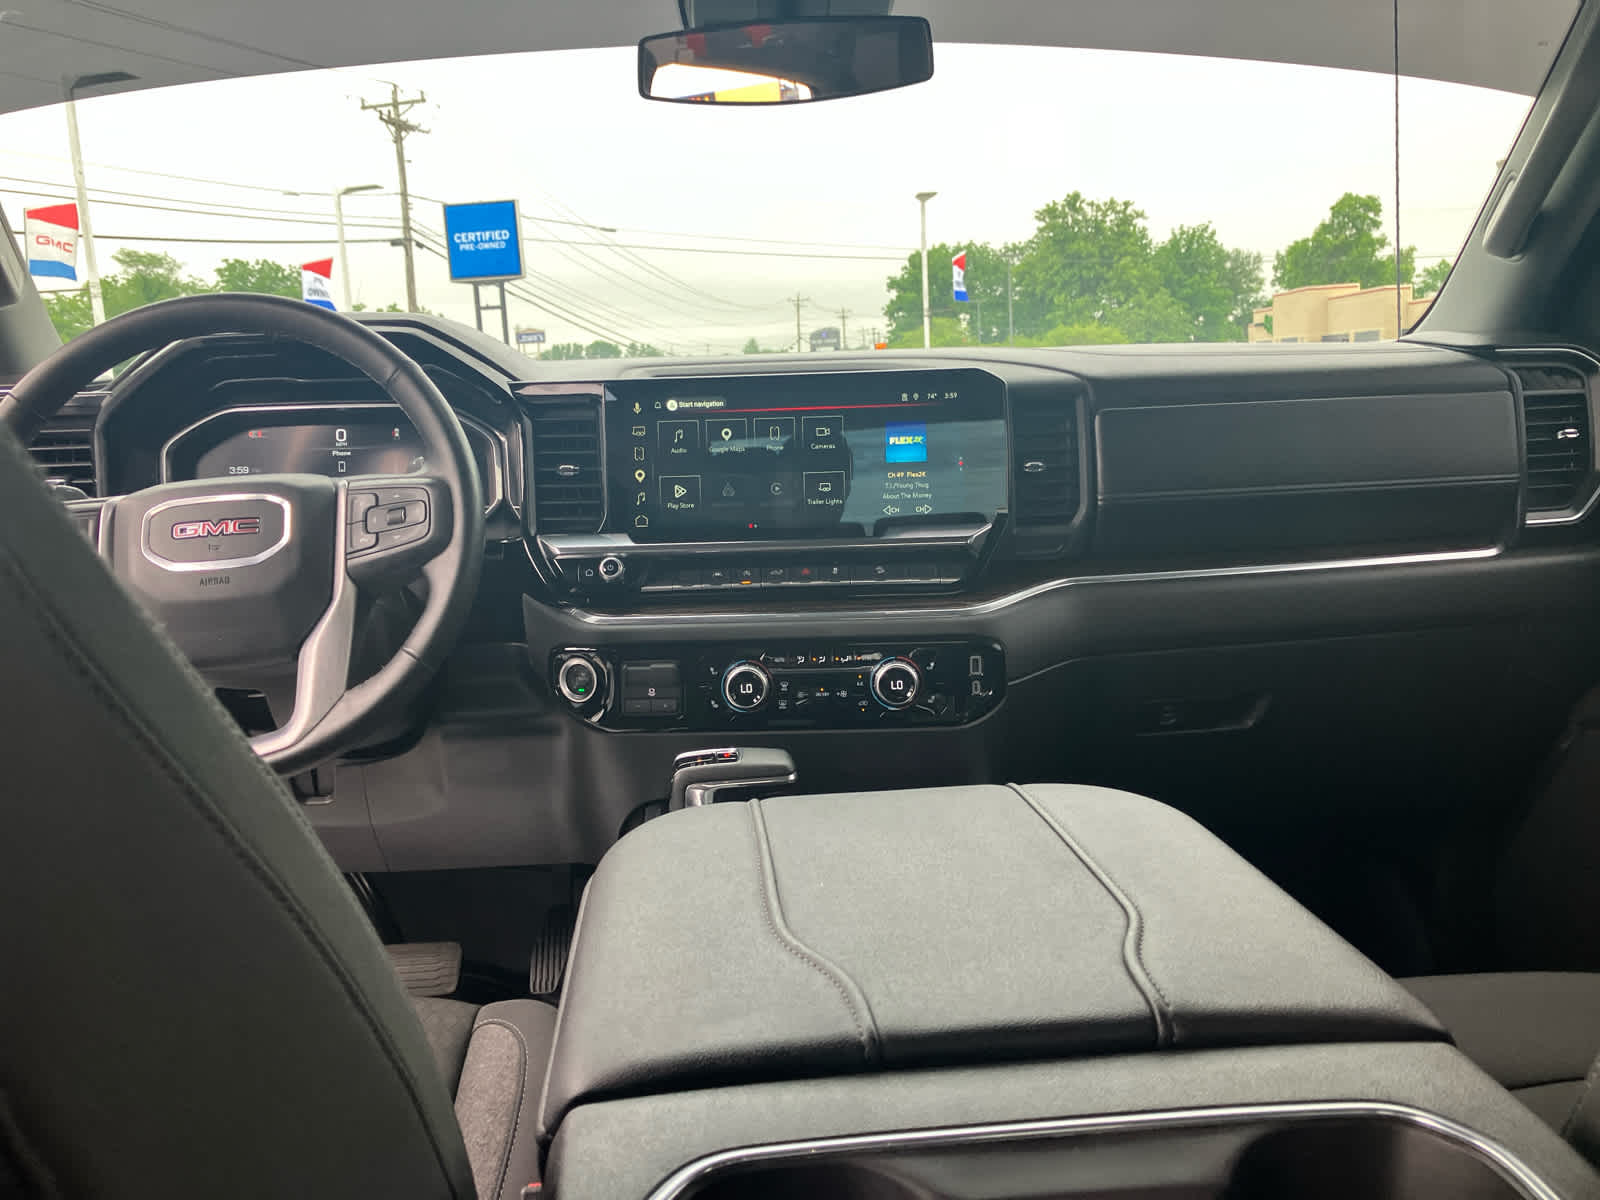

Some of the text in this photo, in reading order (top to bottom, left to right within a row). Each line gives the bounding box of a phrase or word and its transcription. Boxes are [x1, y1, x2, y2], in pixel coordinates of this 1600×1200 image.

[453, 230, 509, 243] CERTIFIED
[36, 234, 73, 254] GMC
[459, 241, 506, 251] PRE-OWNED
[693, 400, 724, 409] navigation
[709, 445, 729, 454] Google
[229, 466, 249, 474] 3:59
[667, 502, 679, 510] Play
[825, 497, 843, 506] Lights
[171, 517, 260, 540] GMC
[199, 576, 230, 587] AIRBAG
[740, 683, 753, 694] LO
[890, 680, 904, 690] LO
